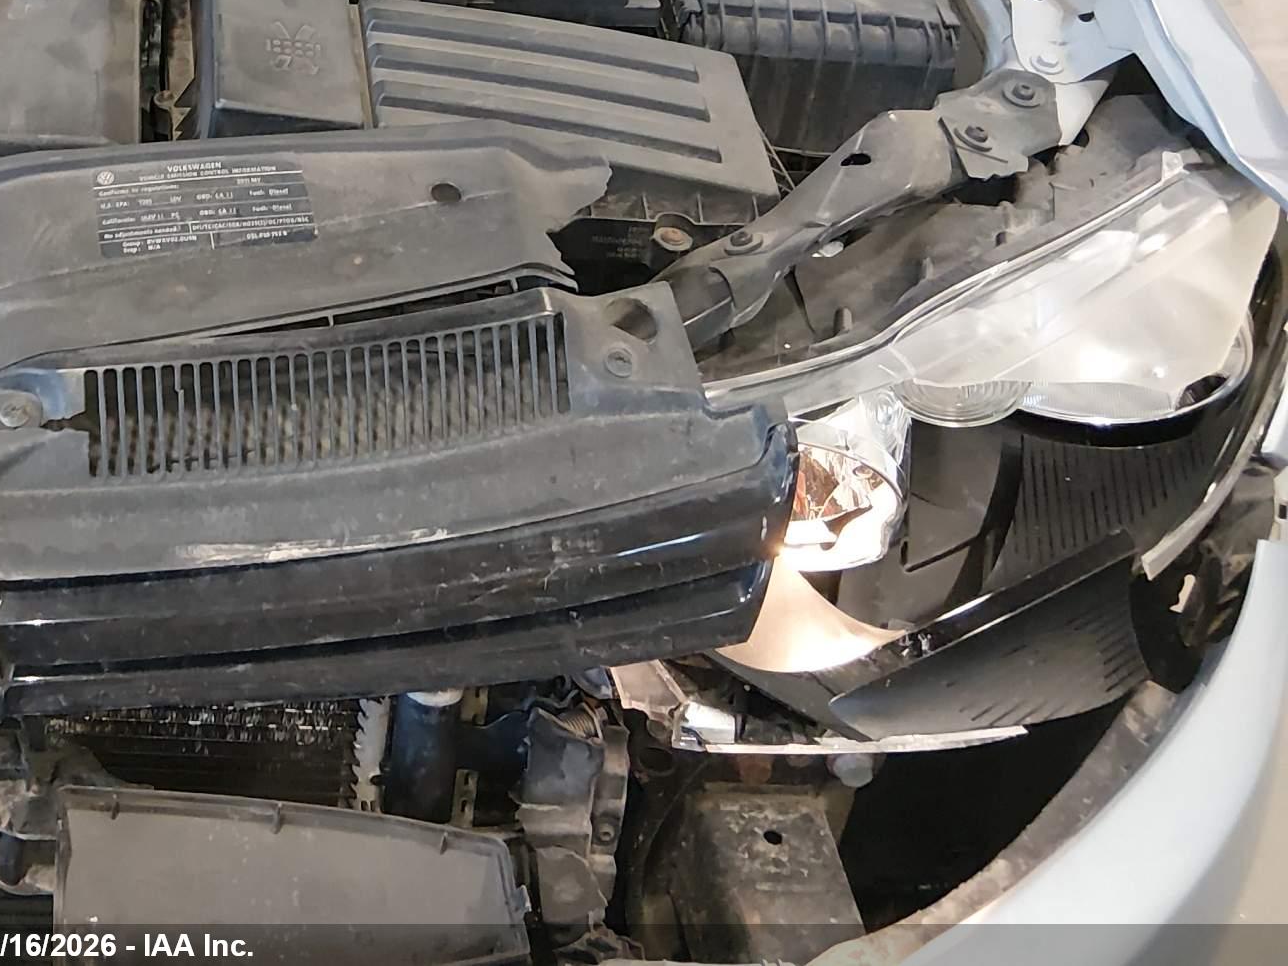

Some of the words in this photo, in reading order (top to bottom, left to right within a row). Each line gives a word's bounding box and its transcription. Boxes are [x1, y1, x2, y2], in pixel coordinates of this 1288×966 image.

[167, 161, 222, 173] VOLKSWAGEN
[200, 168, 229, 177] CONTROL
[231, 165, 276, 174] INFORMATION
